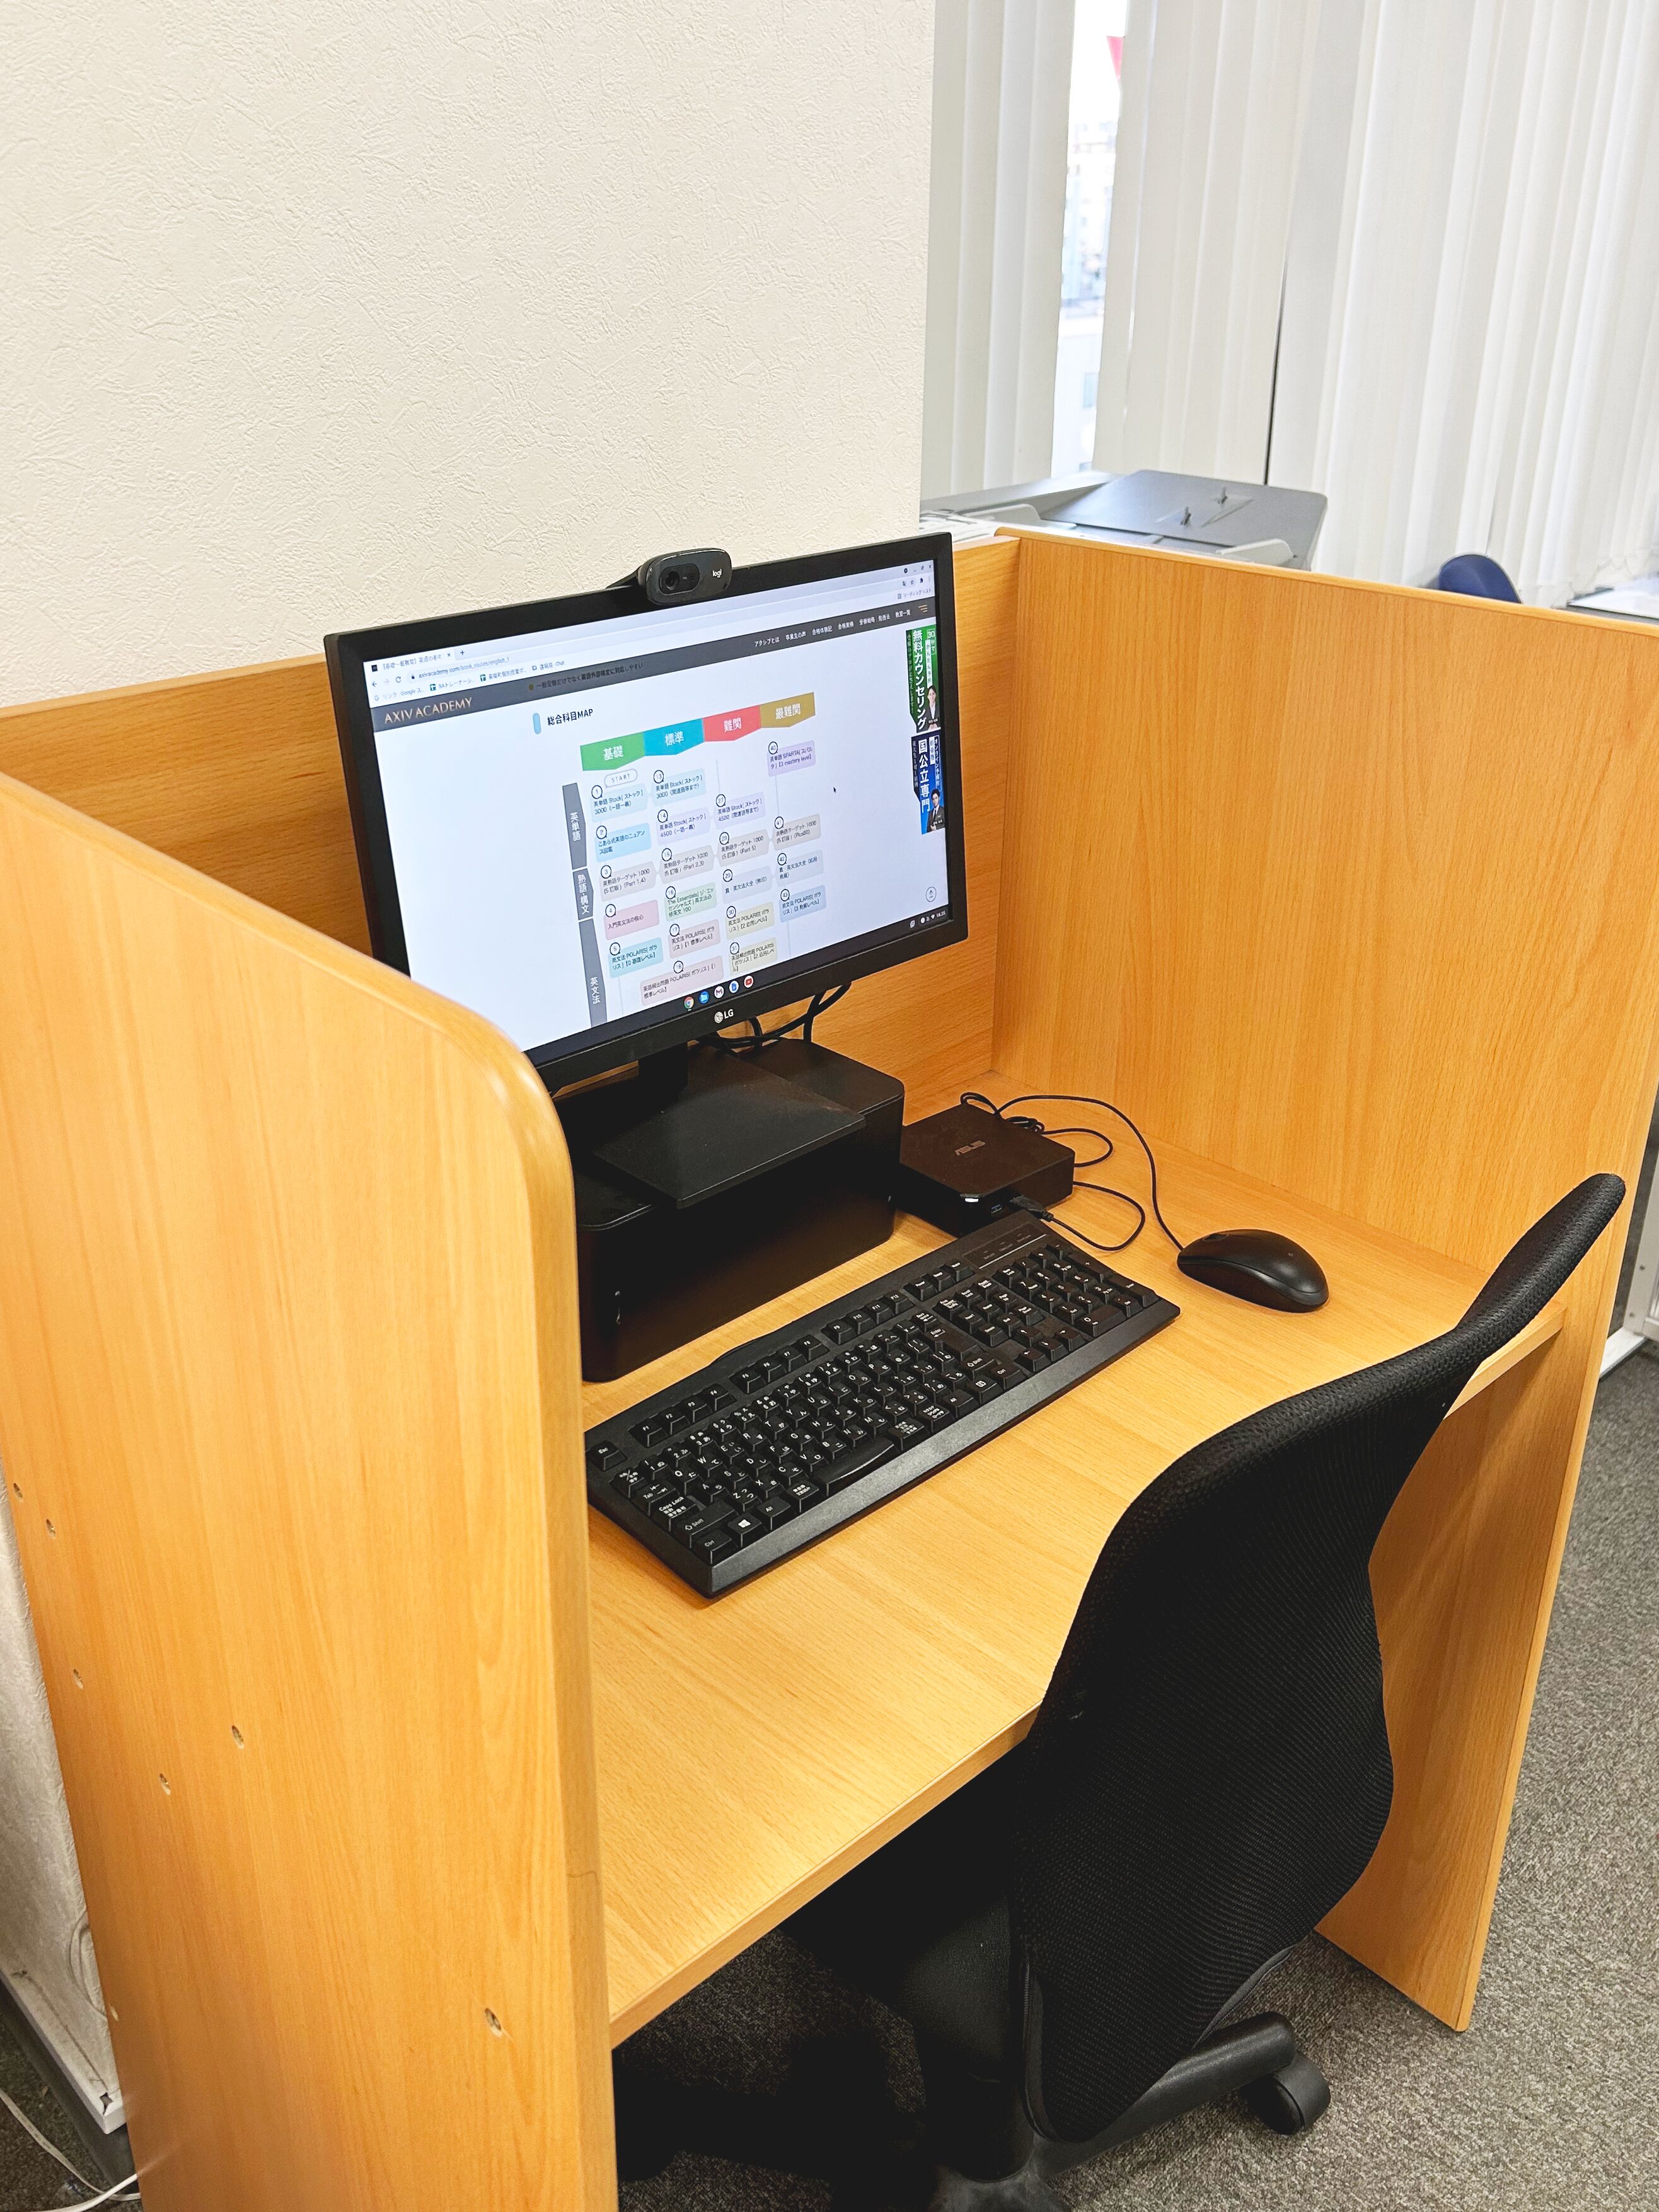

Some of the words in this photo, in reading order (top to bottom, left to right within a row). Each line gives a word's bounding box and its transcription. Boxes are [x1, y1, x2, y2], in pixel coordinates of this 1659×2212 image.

[712, 569, 722, 578] logi
[913, 630, 927, 730] 無料カウンセリング
[384, 709, 412, 724] AXIV
[415, 697, 472, 718] ACADEMY
[547, 709, 593, 726] 総合科目MAP
[775, 703, 801, 720] 最難関
[724, 717, 742, 733] 難関
[665, 731, 684, 746] 標準
[603, 745, 623, 761] 基礎
[611, 773, 630, 783] START
[918, 739, 930, 813] 国公立専門
[590, 976, 601, 1005] 英文法
[724, 1009, 734, 1019] LG
[955, 1140, 986, 1155] ASUS
[691, 1518, 704, 1527] Shift
